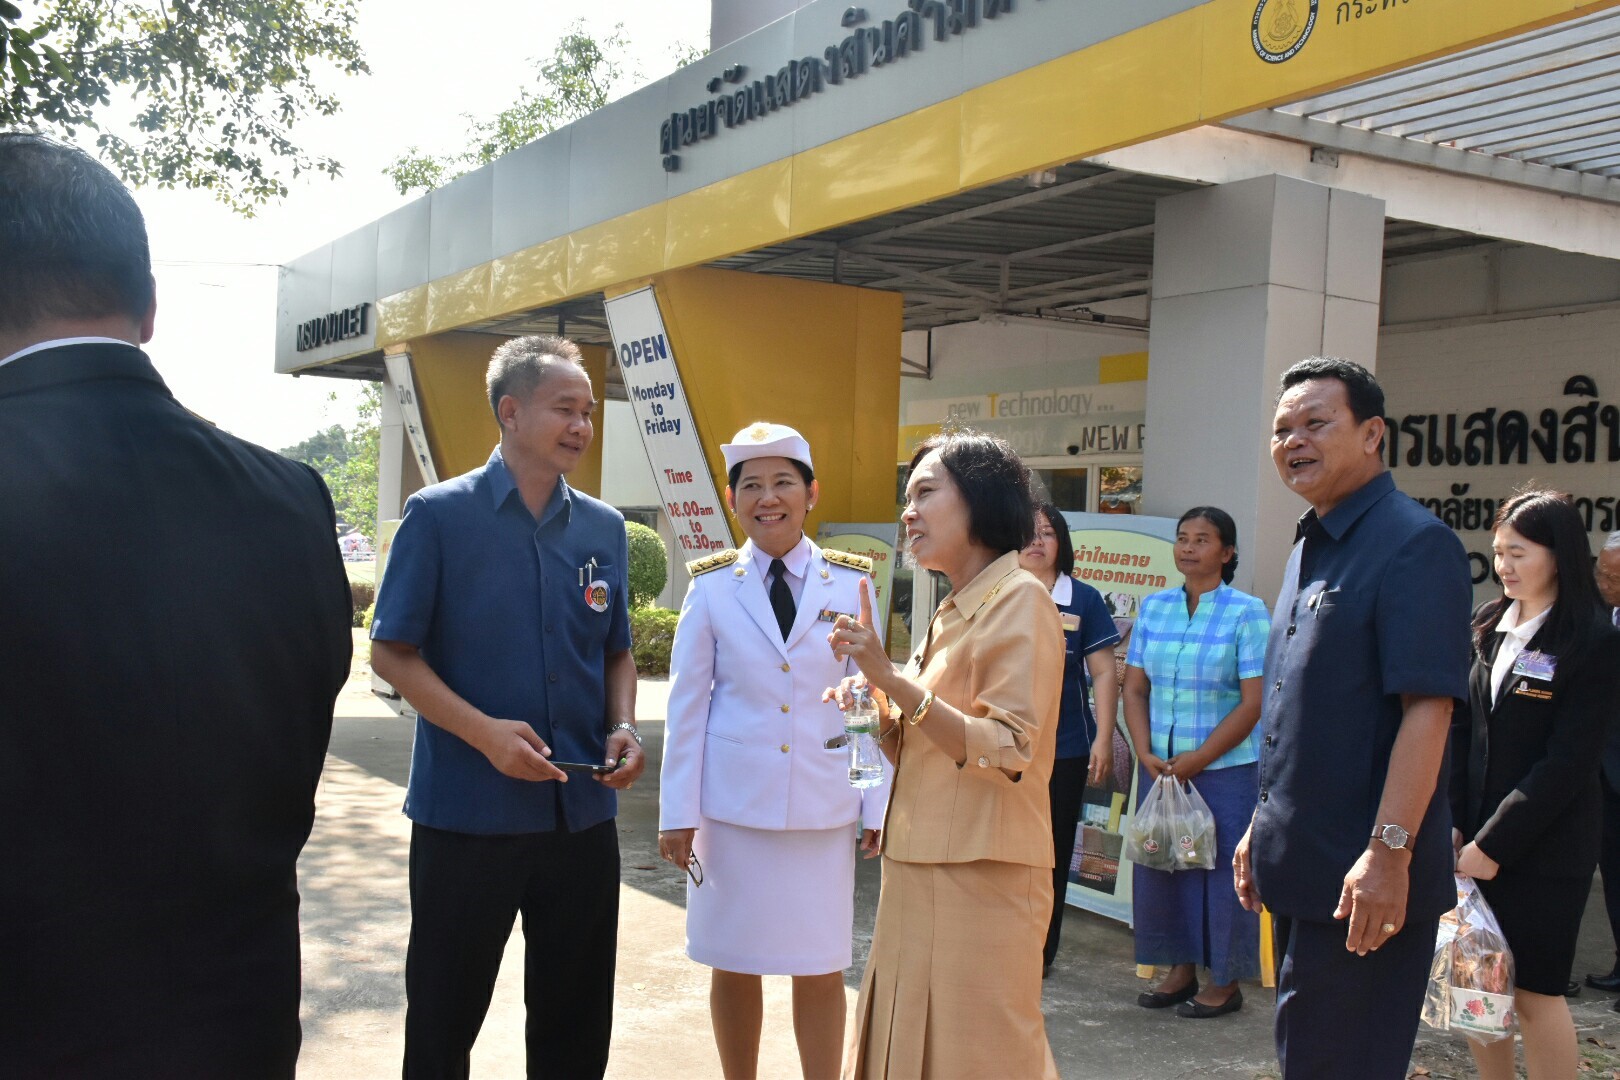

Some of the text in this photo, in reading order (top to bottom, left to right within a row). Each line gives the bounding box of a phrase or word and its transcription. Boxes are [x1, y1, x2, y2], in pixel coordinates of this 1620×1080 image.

[1284, 48, 1295, 58] AND
[1294, 12, 1315, 51] TECHNOLOGY
[297, 302, 371, 352] MSU OUTLET
[620, 334, 668, 368] OPEN
[632, 382, 675, 402] Monday
[651, 402, 664, 416] to
[948, 401, 980, 420] new
[987, 388, 1093, 418] Technology
[644, 418, 681, 436] Friday
[1082, 424, 1129, 451] NEW
[664, 469, 693, 485] Time
[689, 519, 703, 533] to
[679, 534, 724, 551] 16.30pm
[1074, 545, 1151, 567] ผ้าไหมลาย
